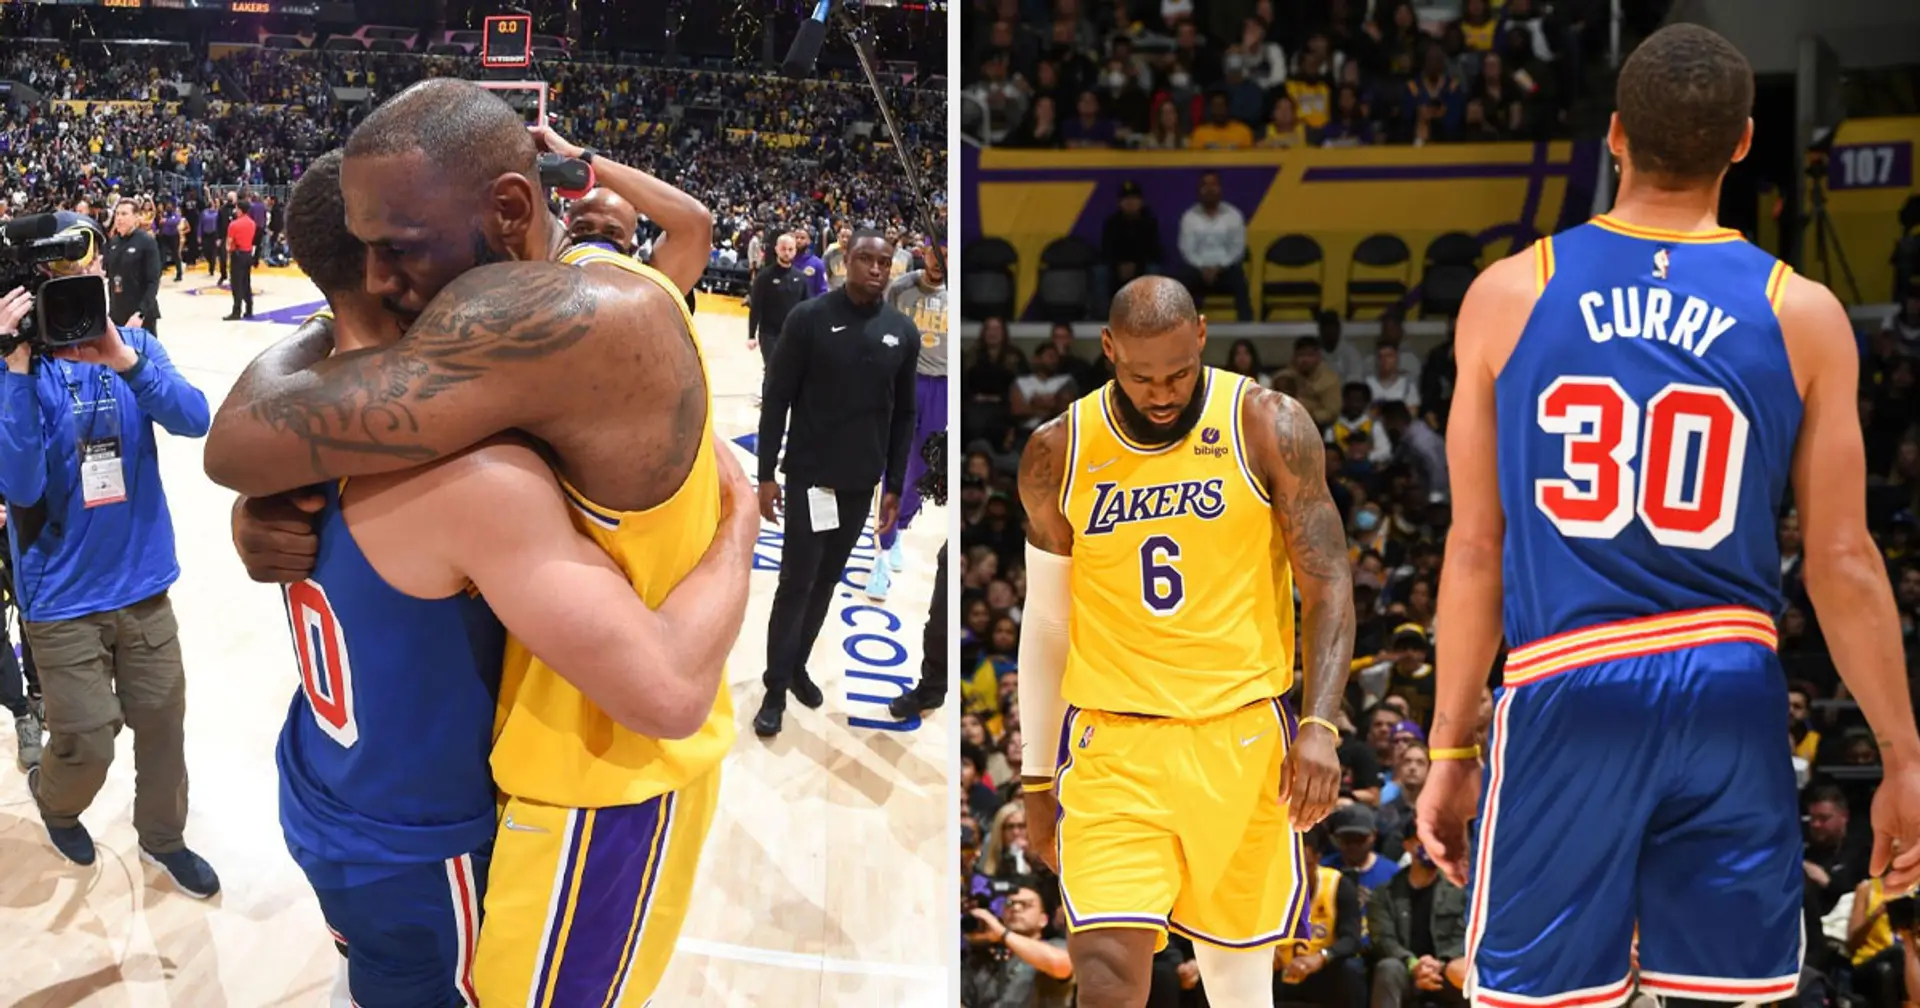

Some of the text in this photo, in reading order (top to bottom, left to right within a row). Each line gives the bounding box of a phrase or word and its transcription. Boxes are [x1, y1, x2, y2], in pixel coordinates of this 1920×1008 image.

[232, 2, 270, 13] LAKERS
[1841, 147, 1894, 186] 107
[1579, 287, 1736, 357] CURRY
[1194, 445, 1229, 458] bibigo
[1535, 375, 1749, 550] 30
[1084, 478, 1227, 536] LAKERS
[1138, 533, 1185, 617] 6
